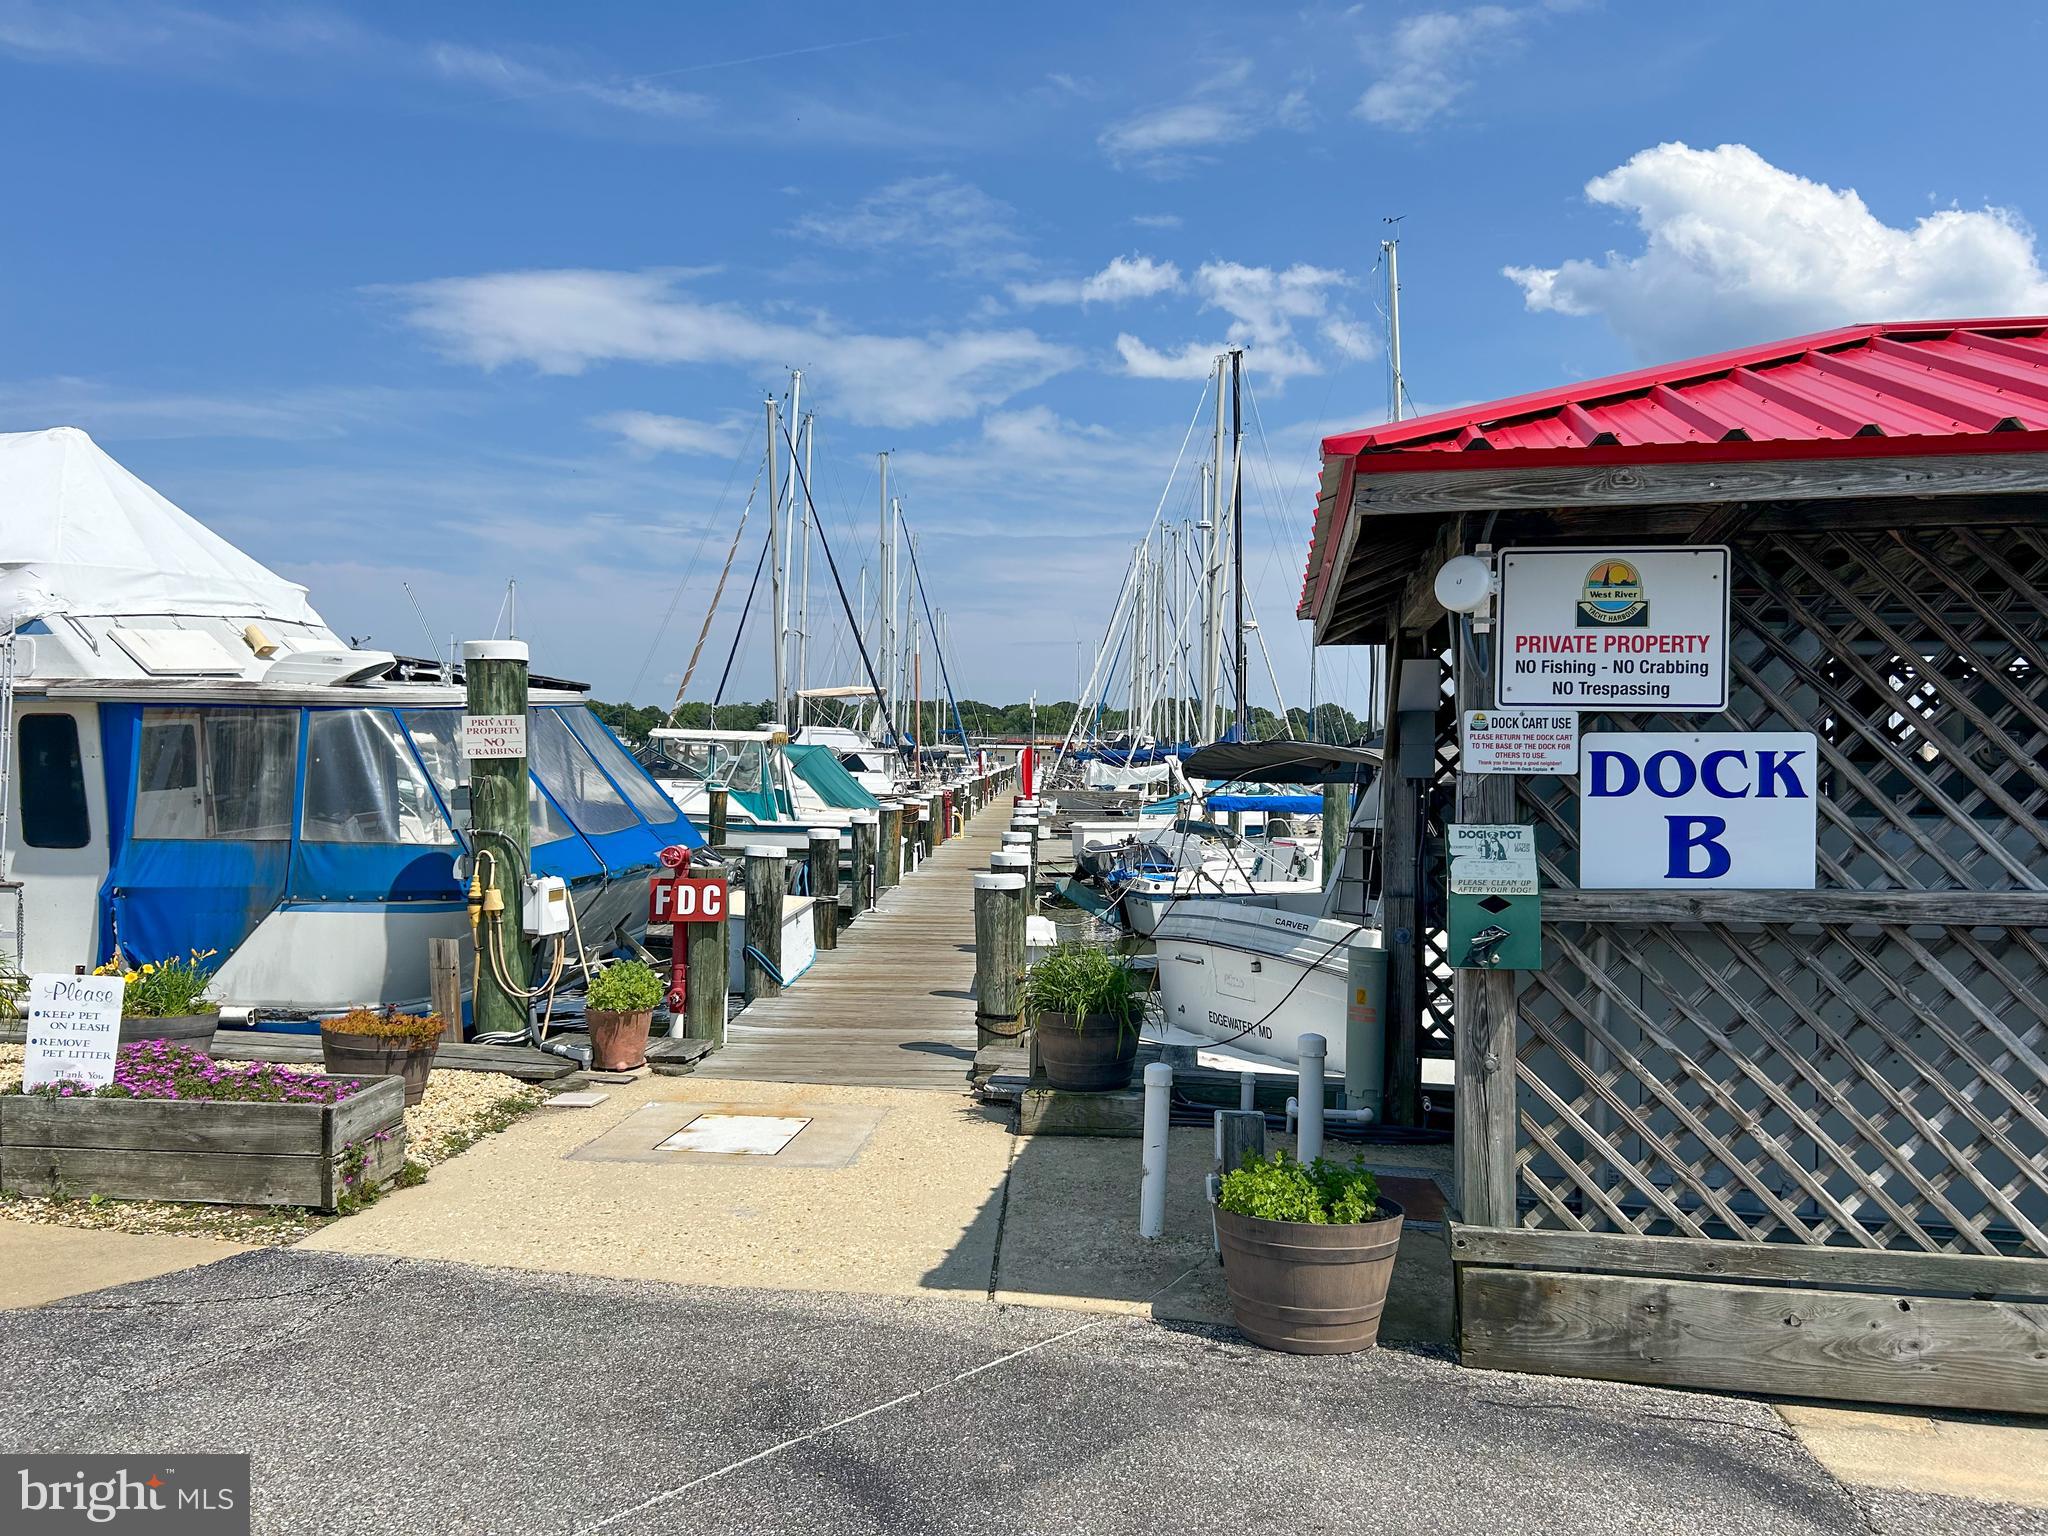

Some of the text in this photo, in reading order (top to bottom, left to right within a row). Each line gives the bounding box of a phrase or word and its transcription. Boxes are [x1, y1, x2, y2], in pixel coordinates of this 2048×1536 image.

[1590, 590, 1638, 598] West River
[1588, 606, 1638, 621] YACHT HARBOUR
[1515, 635, 1711, 653] PRIVATE PROPERTY
[1515, 660, 1536, 674] NO
[1541, 660, 1596, 677] Fishing
[1613, 660, 1634, 674] NO
[1639, 660, 1709, 677] Crabbing
[1552, 681, 1670, 698] NO Trespassing
[471, 719, 517, 727] PRIVATE
[1491, 717, 1571, 729] DOCK CART USE
[466, 727, 520, 735] PROPERTY
[483, 738, 505, 747] NO
[1524, 742, 1536, 750] THE
[1538, 742, 1556, 750] DOCK
[467, 747, 522, 755] CRABBING
[1588, 750, 1808, 798] DOCK
[1664, 815, 1731, 878] B
[655, 885, 721, 915] FDC
[1275, 917, 1309, 932] CARVER
[45, 981, 113, 1003] Please
[42, 1010, 101, 1020] KEEP PET
[50, 1021, 110, 1032] ON LEASH
[1258, 1025, 1273, 1040] MD
[39, 1038, 91, 1047] REMOVE
[42, 1049, 111, 1060] PET LITTER
